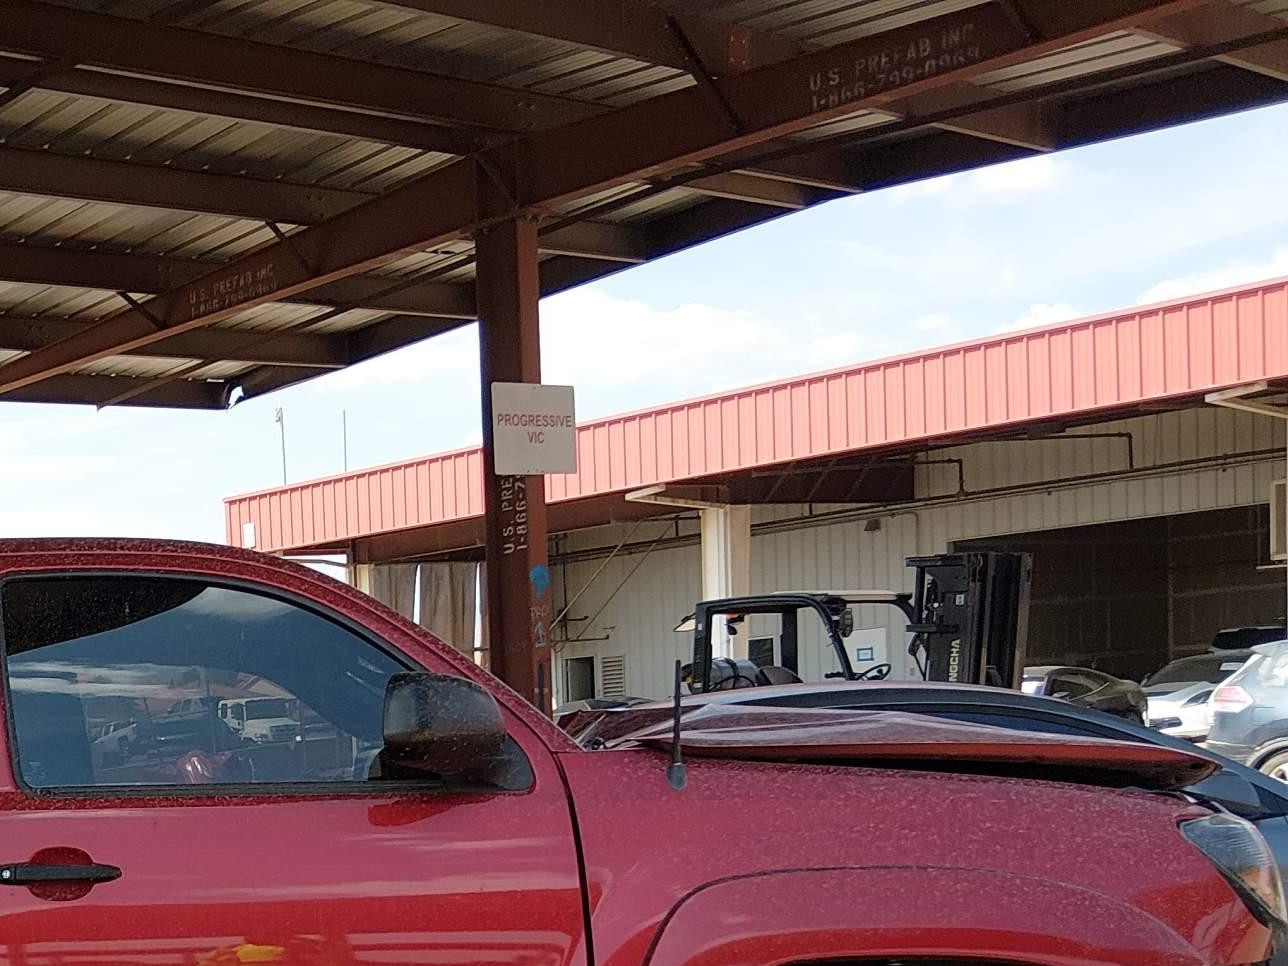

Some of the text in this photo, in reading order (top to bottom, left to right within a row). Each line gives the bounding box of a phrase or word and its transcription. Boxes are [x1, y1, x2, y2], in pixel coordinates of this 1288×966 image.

[854, 38, 931, 78] PREFAB
[213, 271, 253, 297] PREFAB
[497, 413, 572, 428] PROGRESSIVE
[527, 431, 545, 444] VIC
[501, 474, 515, 554] U.S. PRE
[514, 475, 528, 550] 1-866-7
[948, 639, 961, 682] NGCHA
